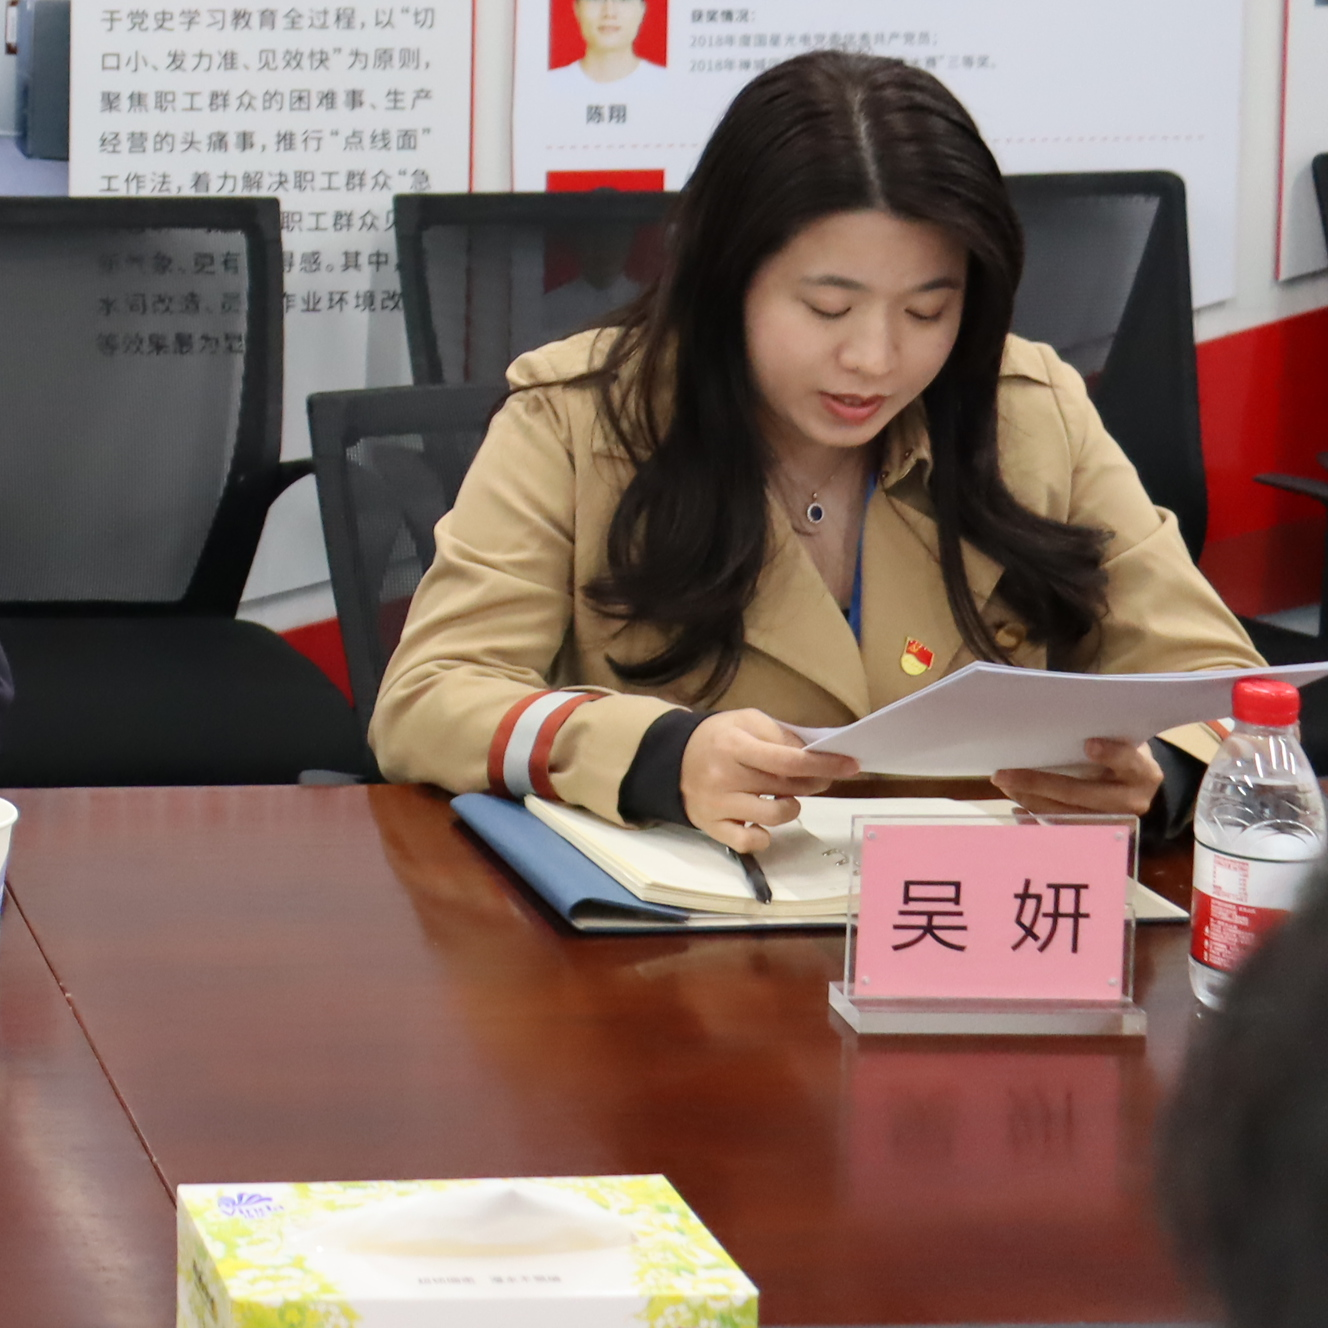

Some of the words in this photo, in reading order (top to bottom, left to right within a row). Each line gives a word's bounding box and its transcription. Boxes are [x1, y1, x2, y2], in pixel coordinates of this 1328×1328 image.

[100, 89, 434, 114] 聚焦职工群众的困难事、生产
[585, 104, 628, 125] 陈翔
[891, 878, 1090, 954] 吴妍
